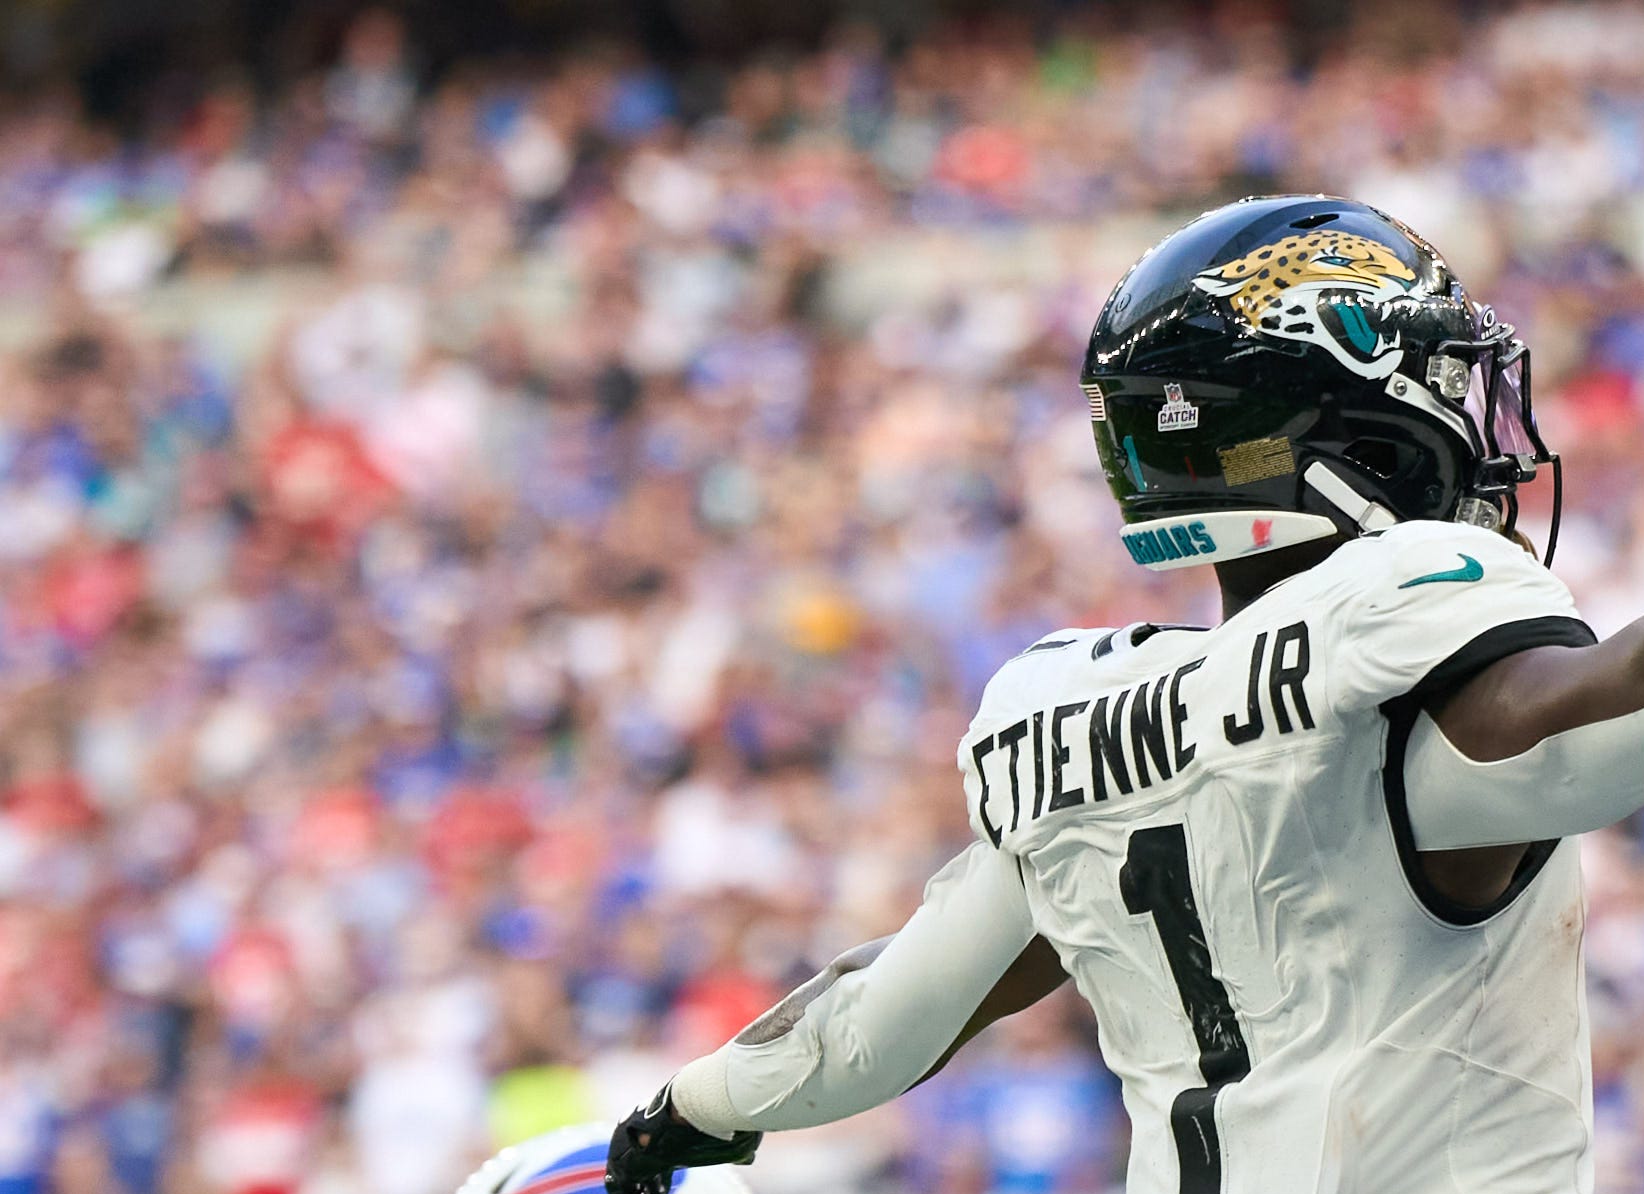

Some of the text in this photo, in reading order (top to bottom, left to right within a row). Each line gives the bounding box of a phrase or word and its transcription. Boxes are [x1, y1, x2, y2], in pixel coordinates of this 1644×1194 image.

[1160, 409, 1197, 424] CATCH
[972, 620, 1315, 849] ETIENNE JR
